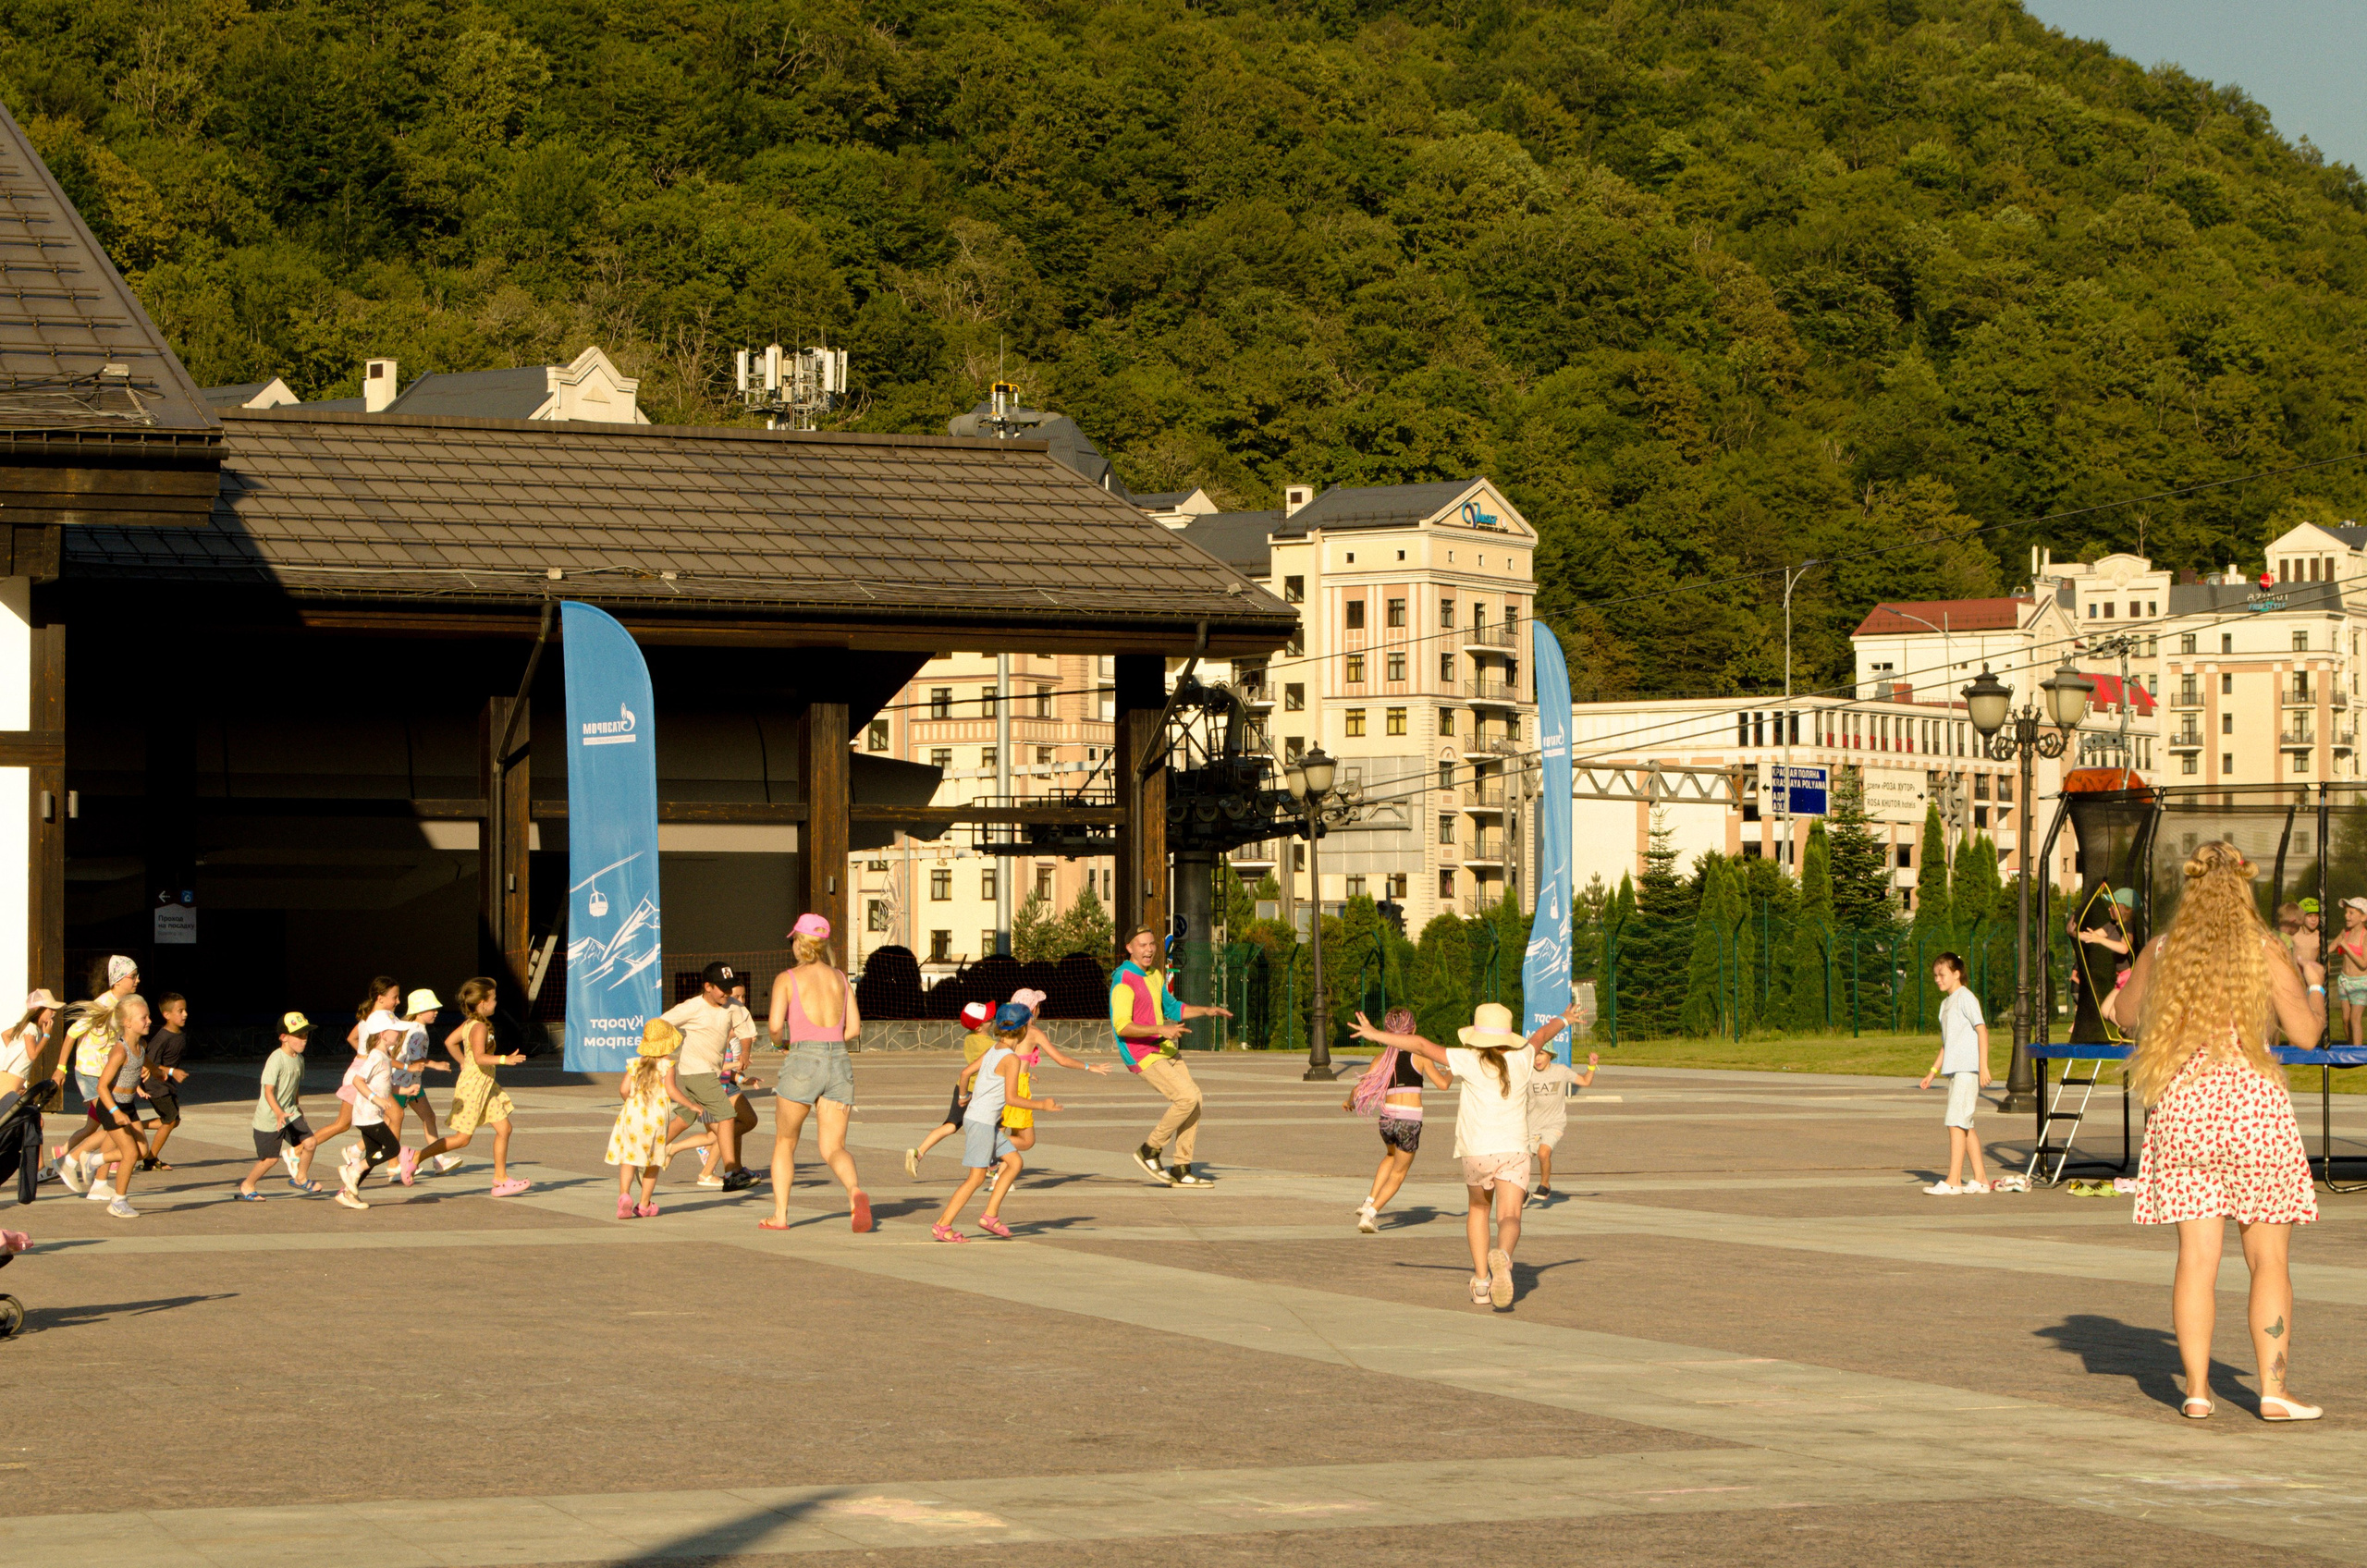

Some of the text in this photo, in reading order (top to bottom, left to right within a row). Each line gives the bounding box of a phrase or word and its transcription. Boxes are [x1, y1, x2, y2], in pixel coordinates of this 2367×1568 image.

[1827, 732, 1914, 753] KARTING
[1772, 767, 1821, 779] КРАСАЯ ПОЛЯНА
[1772, 778, 1826, 790] KRASAYA POLYANA
[1867, 798, 1917, 809] ROSA KHUTOR hotels
[1532, 1081, 1562, 1094] EA7
